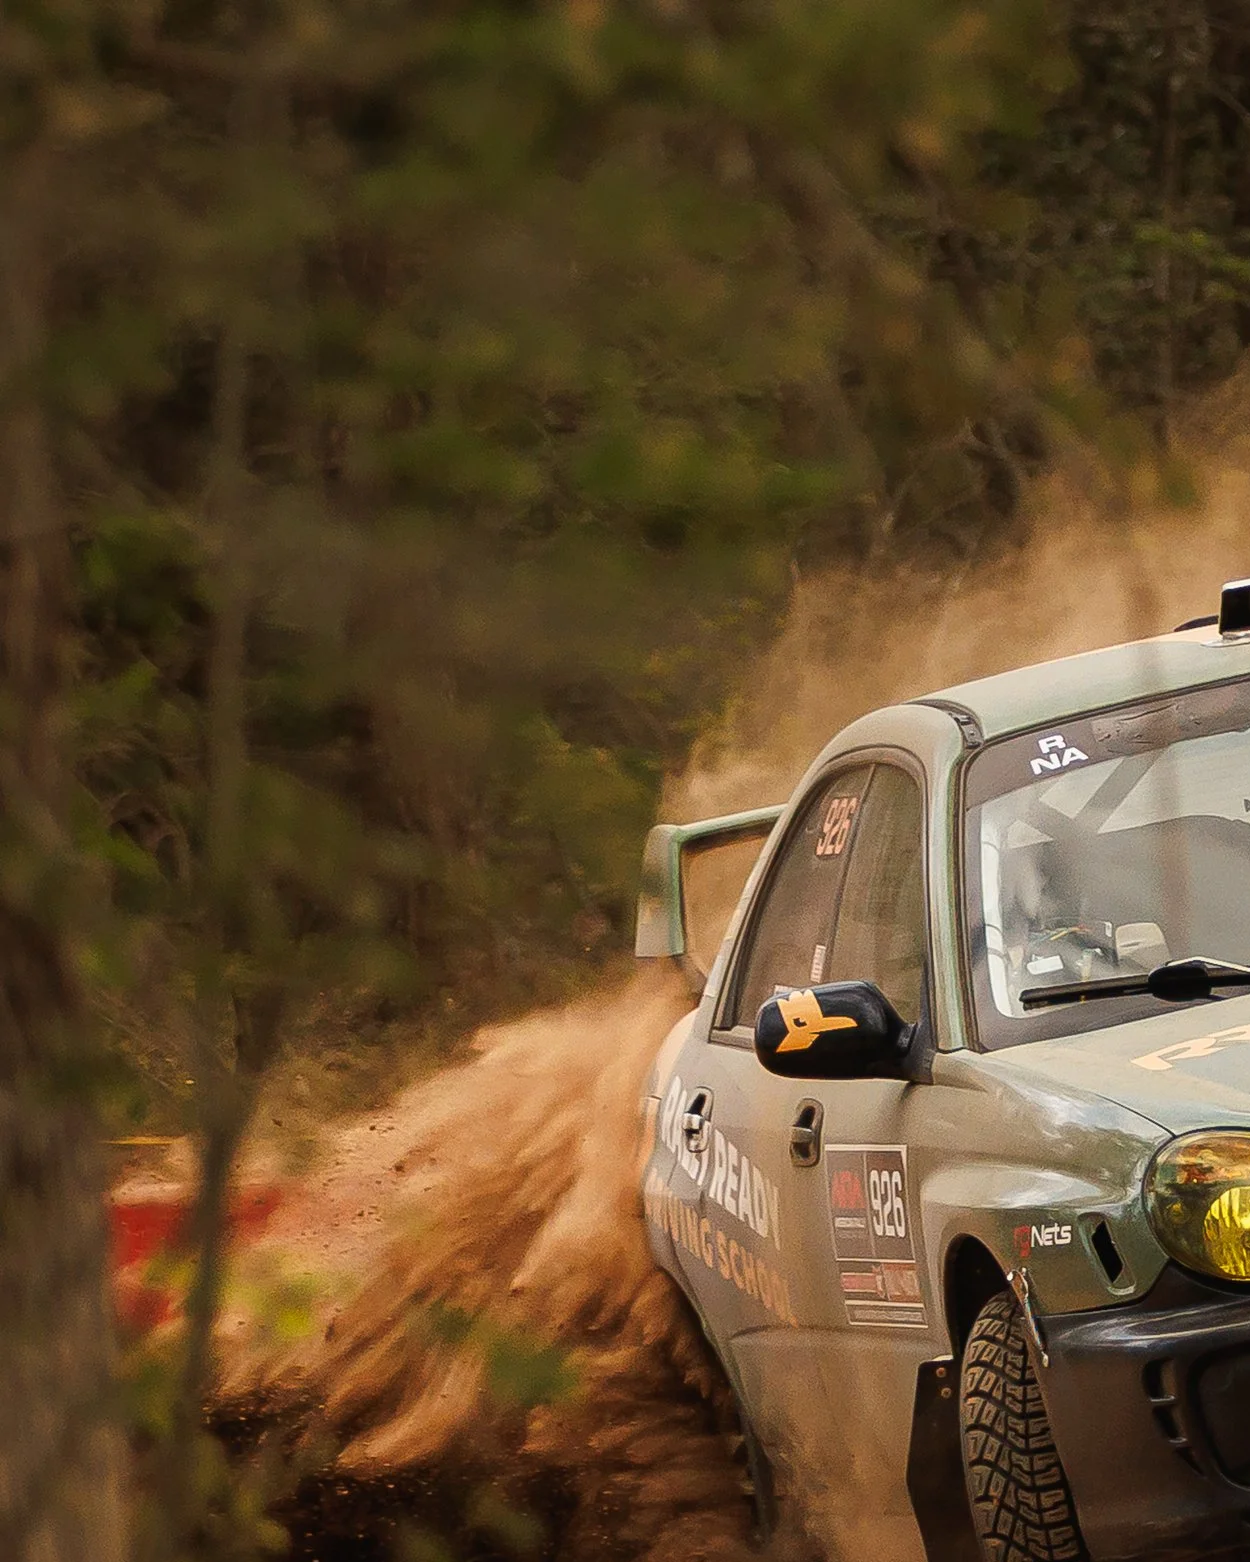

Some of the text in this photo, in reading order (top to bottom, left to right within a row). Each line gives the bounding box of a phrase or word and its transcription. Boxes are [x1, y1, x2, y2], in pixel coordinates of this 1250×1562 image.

[1029, 746, 1090, 776] NA
[1038, 734, 1067, 754] R
[816, 797, 859, 857] 926
[708, 1128, 782, 1251] READY
[869, 1168, 907, 1239] 926
